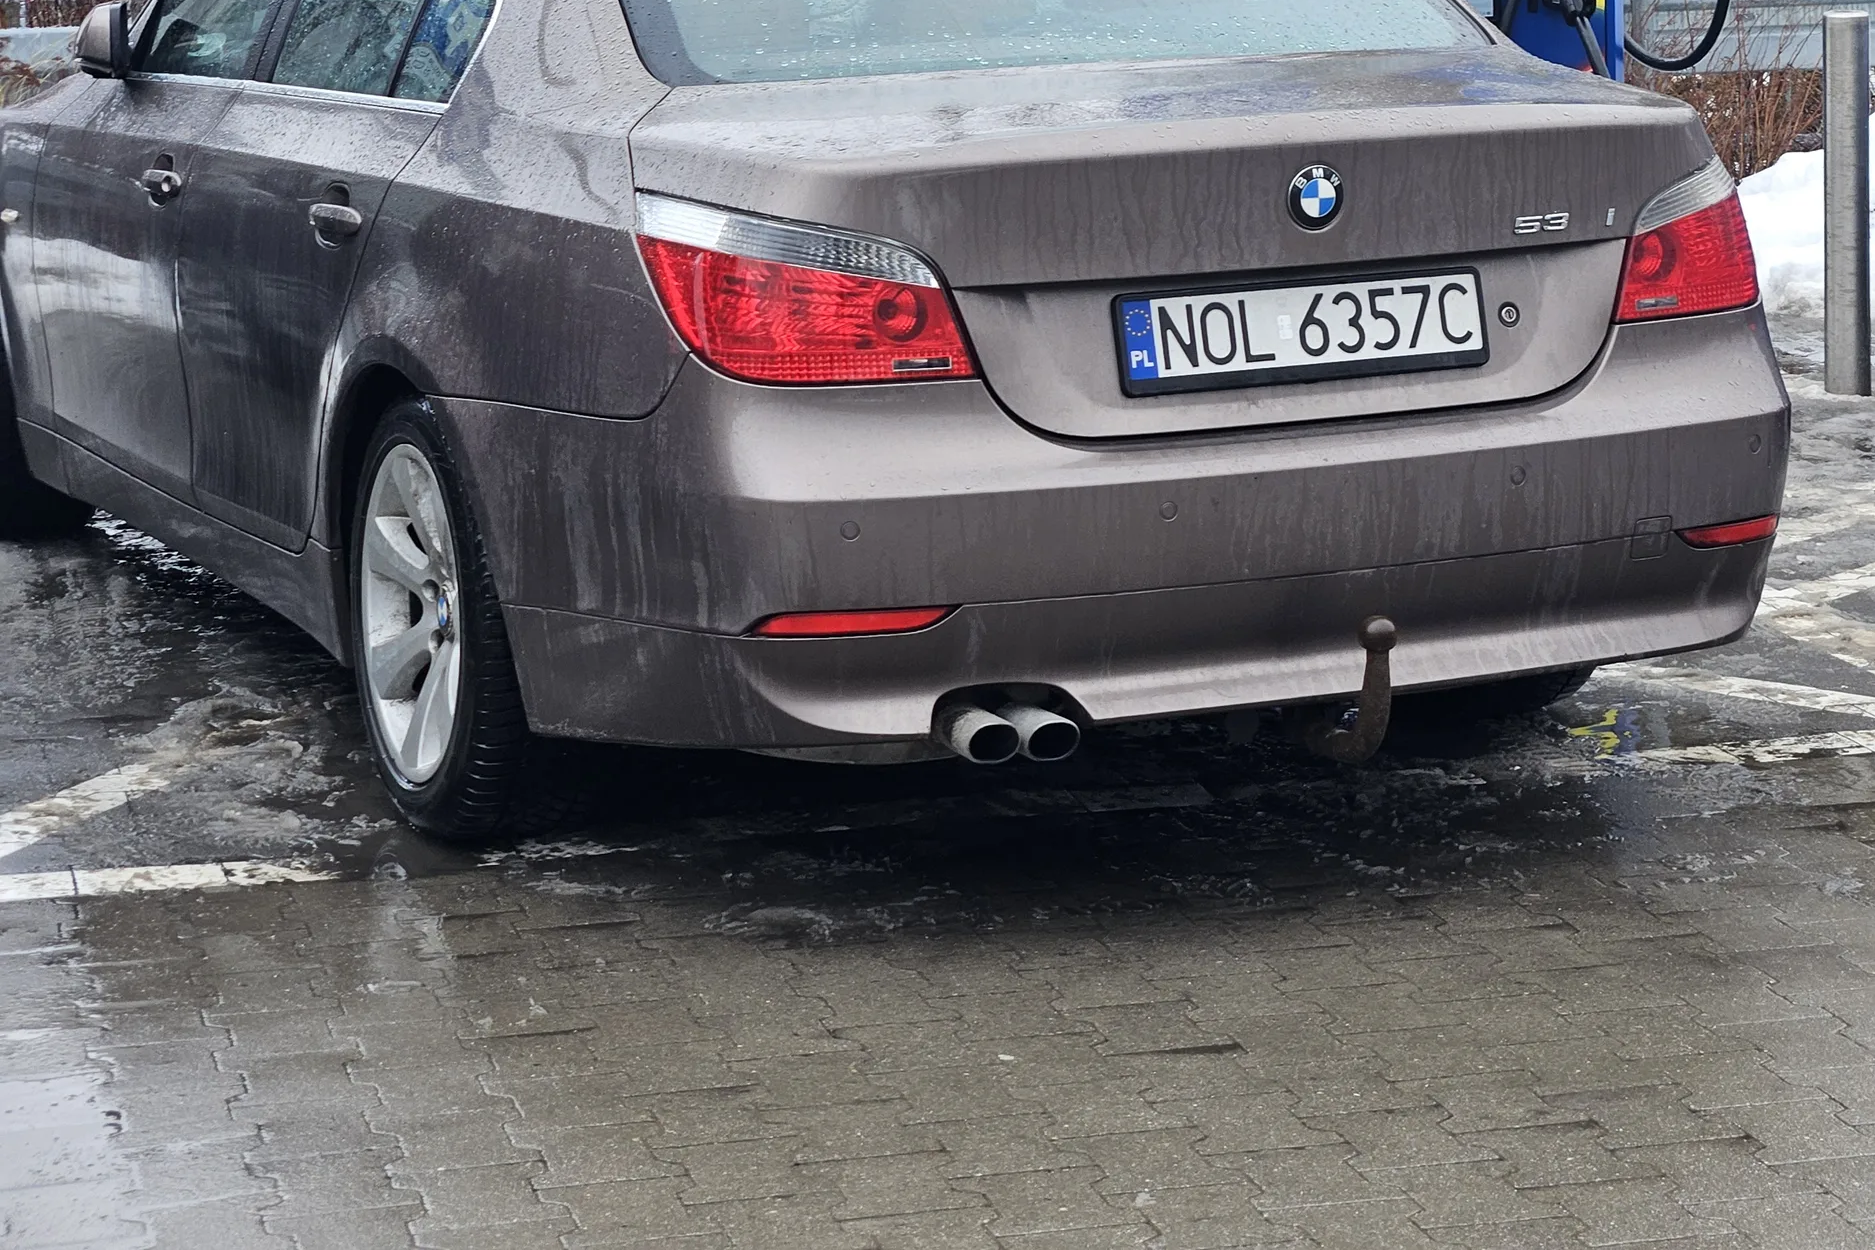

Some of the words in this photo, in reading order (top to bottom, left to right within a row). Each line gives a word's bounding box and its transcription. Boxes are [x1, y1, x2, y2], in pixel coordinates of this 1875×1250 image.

[1294, 167, 1341, 190] BMW
[1130, 350, 1155, 370] PL
[1157, 298, 1277, 371] NOL
[1298, 280, 1476, 358] 6357C
